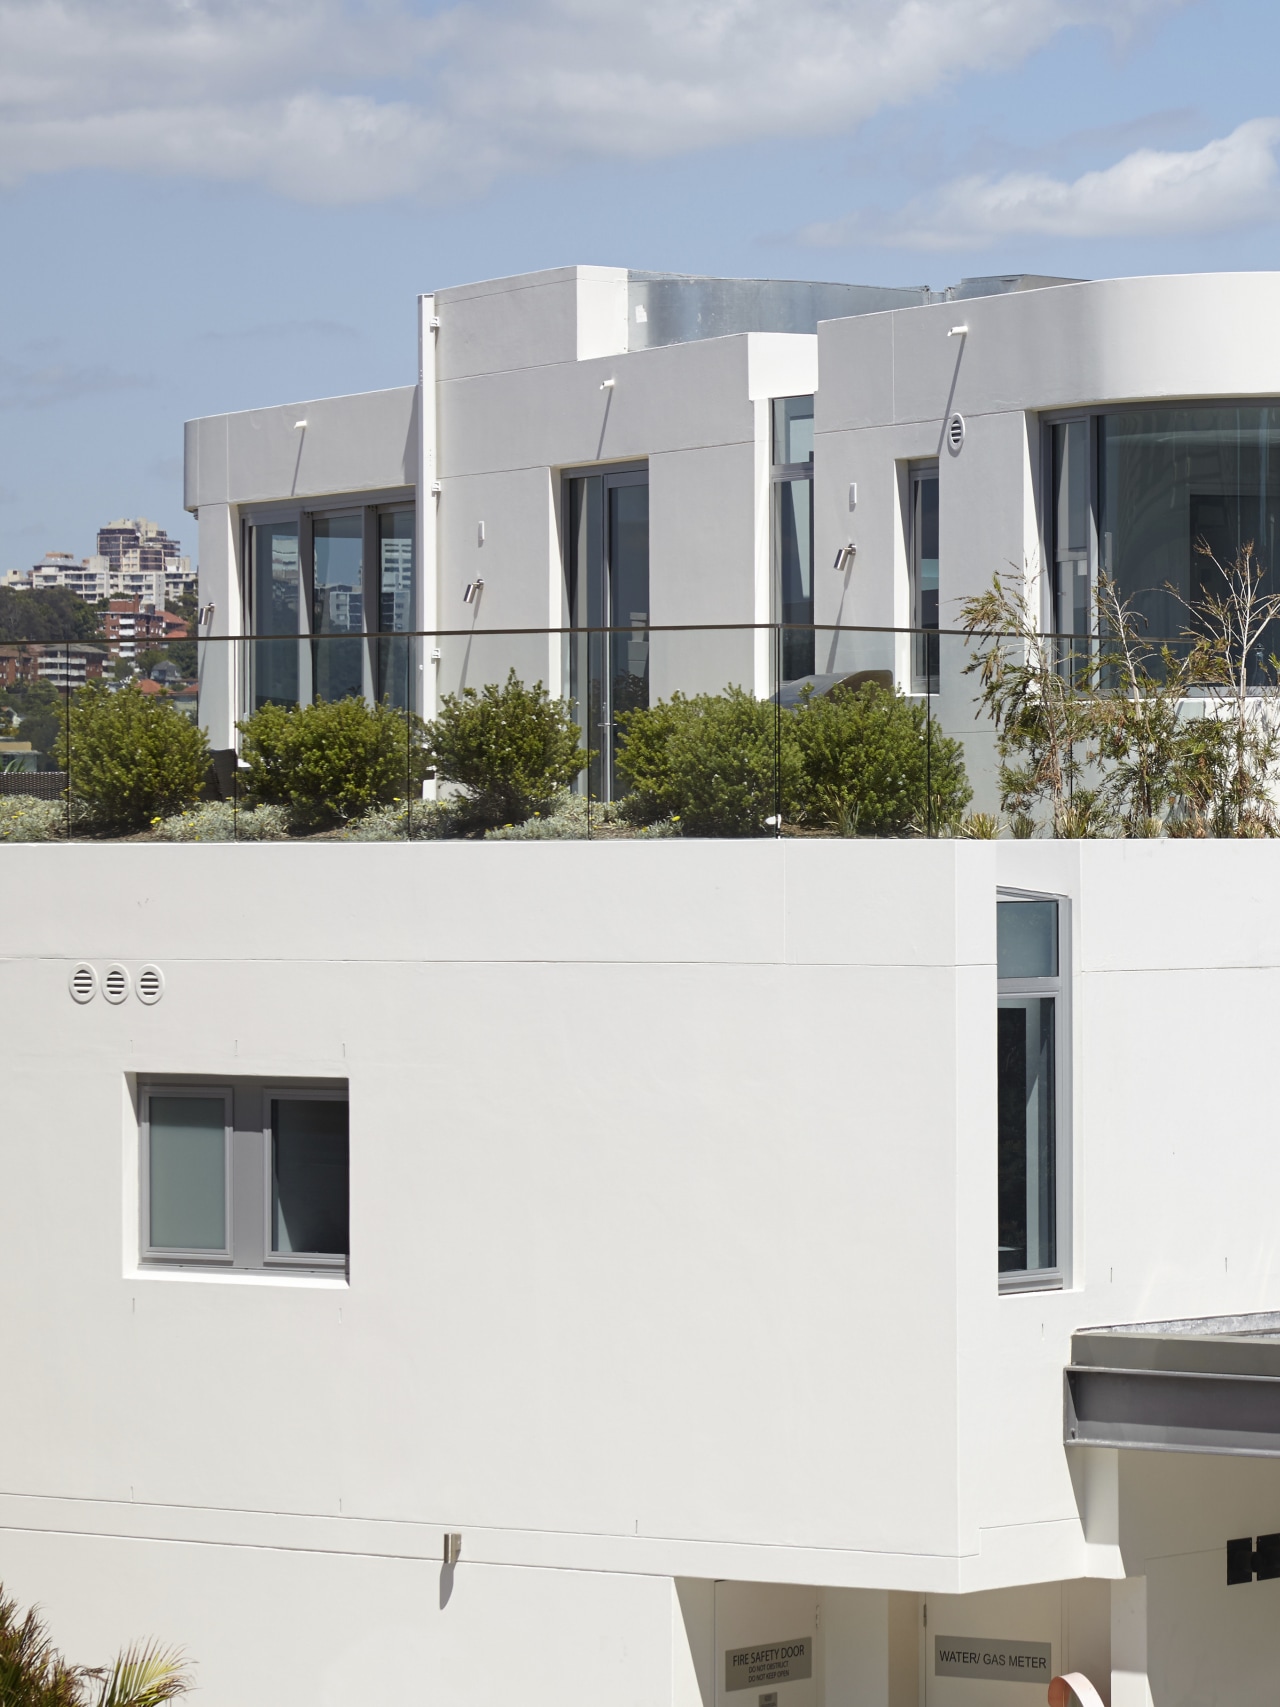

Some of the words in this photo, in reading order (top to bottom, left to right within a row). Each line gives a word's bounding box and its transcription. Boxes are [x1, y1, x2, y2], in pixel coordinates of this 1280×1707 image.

[733, 1653, 749, 1666] FIRE
[750, 1648, 779, 1663] SAFETY
[781, 1645, 804, 1658] DOOR
[939, 1650, 981, 1664] WATER/
[983, 1653, 1006, 1666] GAS
[1008, 1655, 1047, 1669] METER
[767, 1661, 788, 1670] OBSTRUCT
